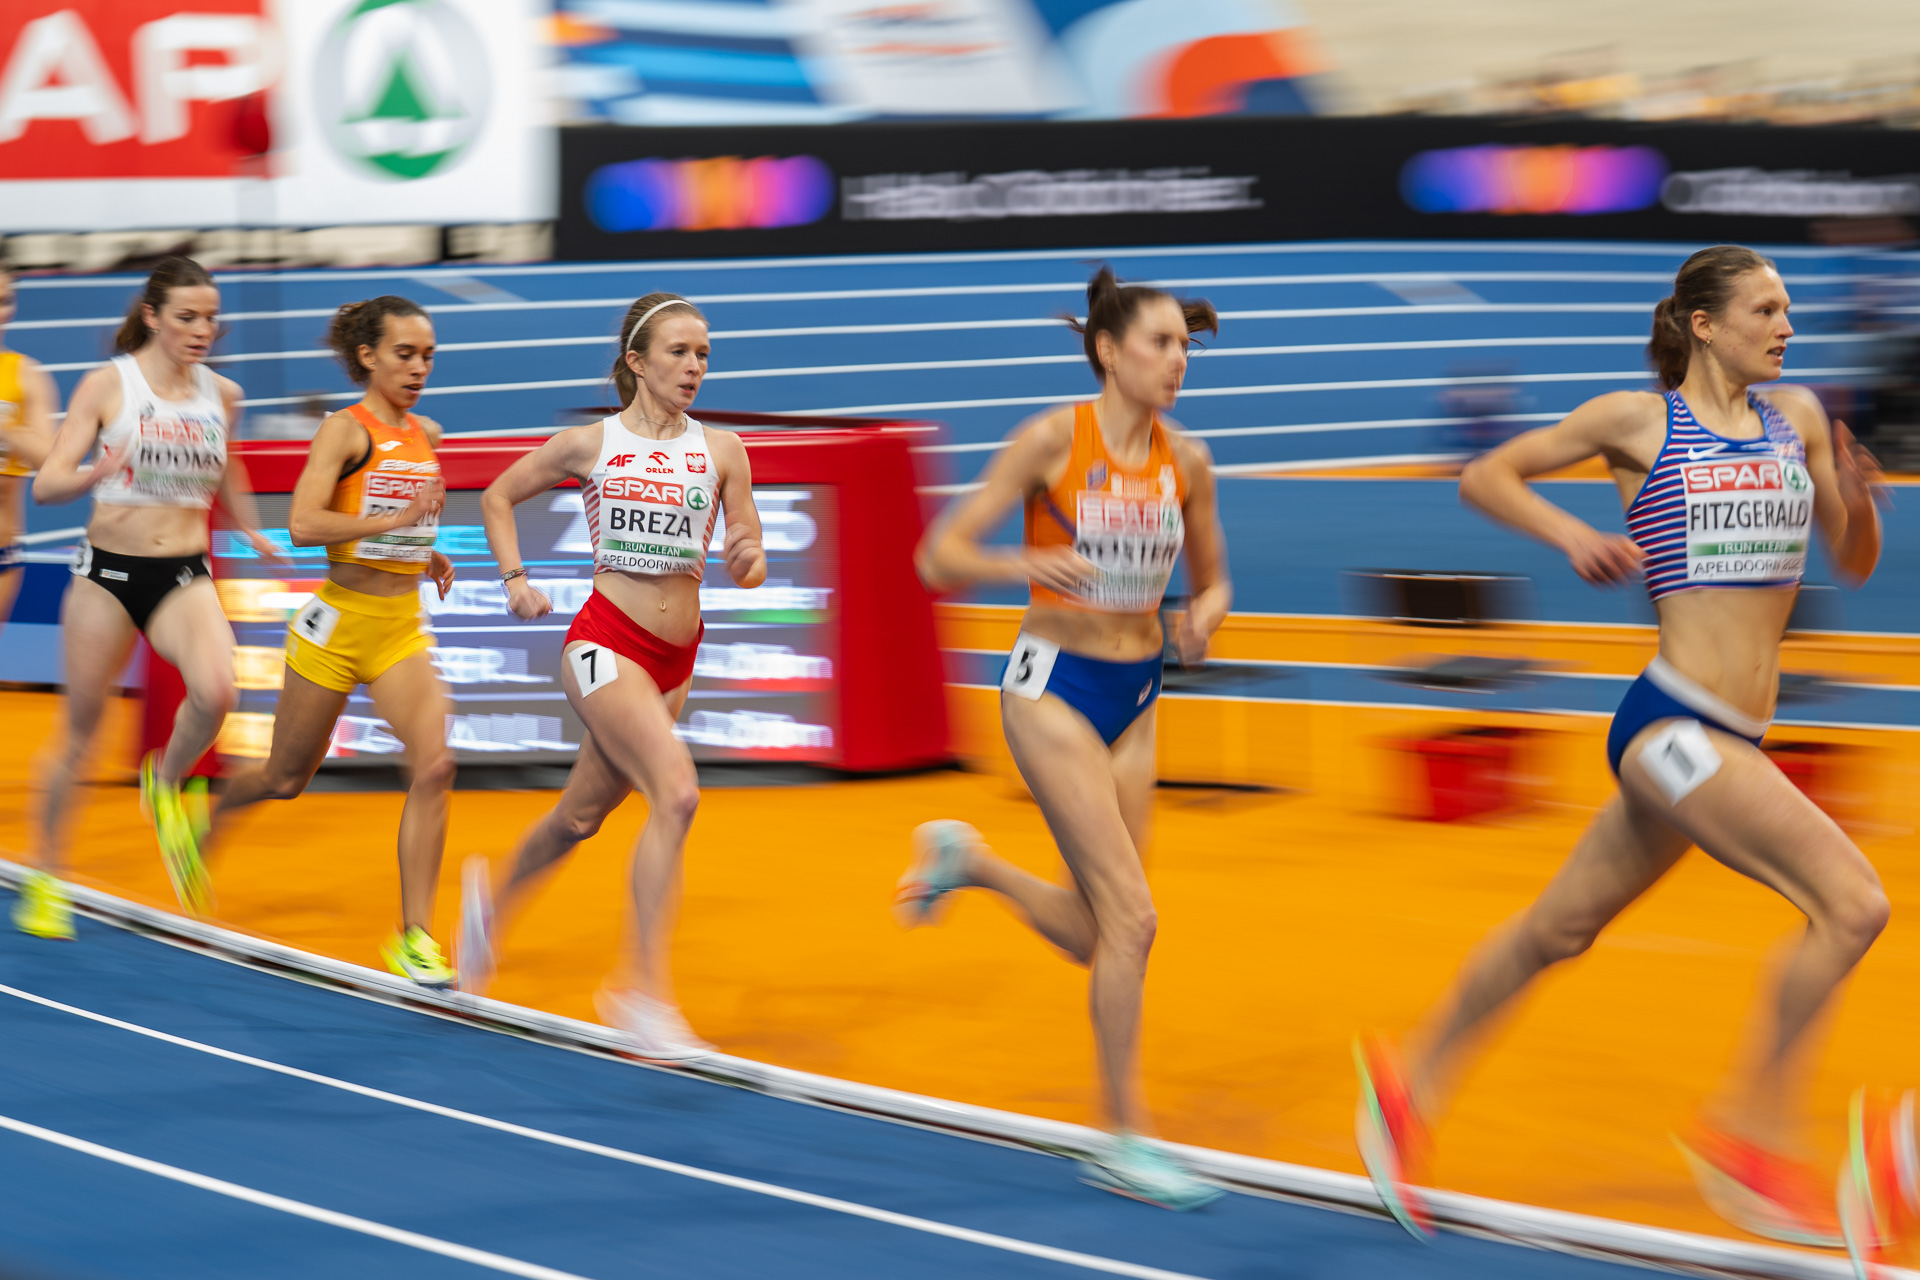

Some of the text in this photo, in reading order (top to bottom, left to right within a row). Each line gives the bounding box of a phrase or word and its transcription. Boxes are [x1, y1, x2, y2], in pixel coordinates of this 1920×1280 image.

[1688, 463, 1781, 490] SPAR
[605, 479, 683, 503] SPAR
[610, 507, 692, 539] BREZA
[1690, 500, 1809, 531] FITZGERALD
[625, 542, 647, 553] RUN
[648, 545, 681, 557] CLEAN
[1724, 542, 1752, 553] RUN
[601, 554, 672, 571] APELDOORN
[580, 648, 598, 685] 7
